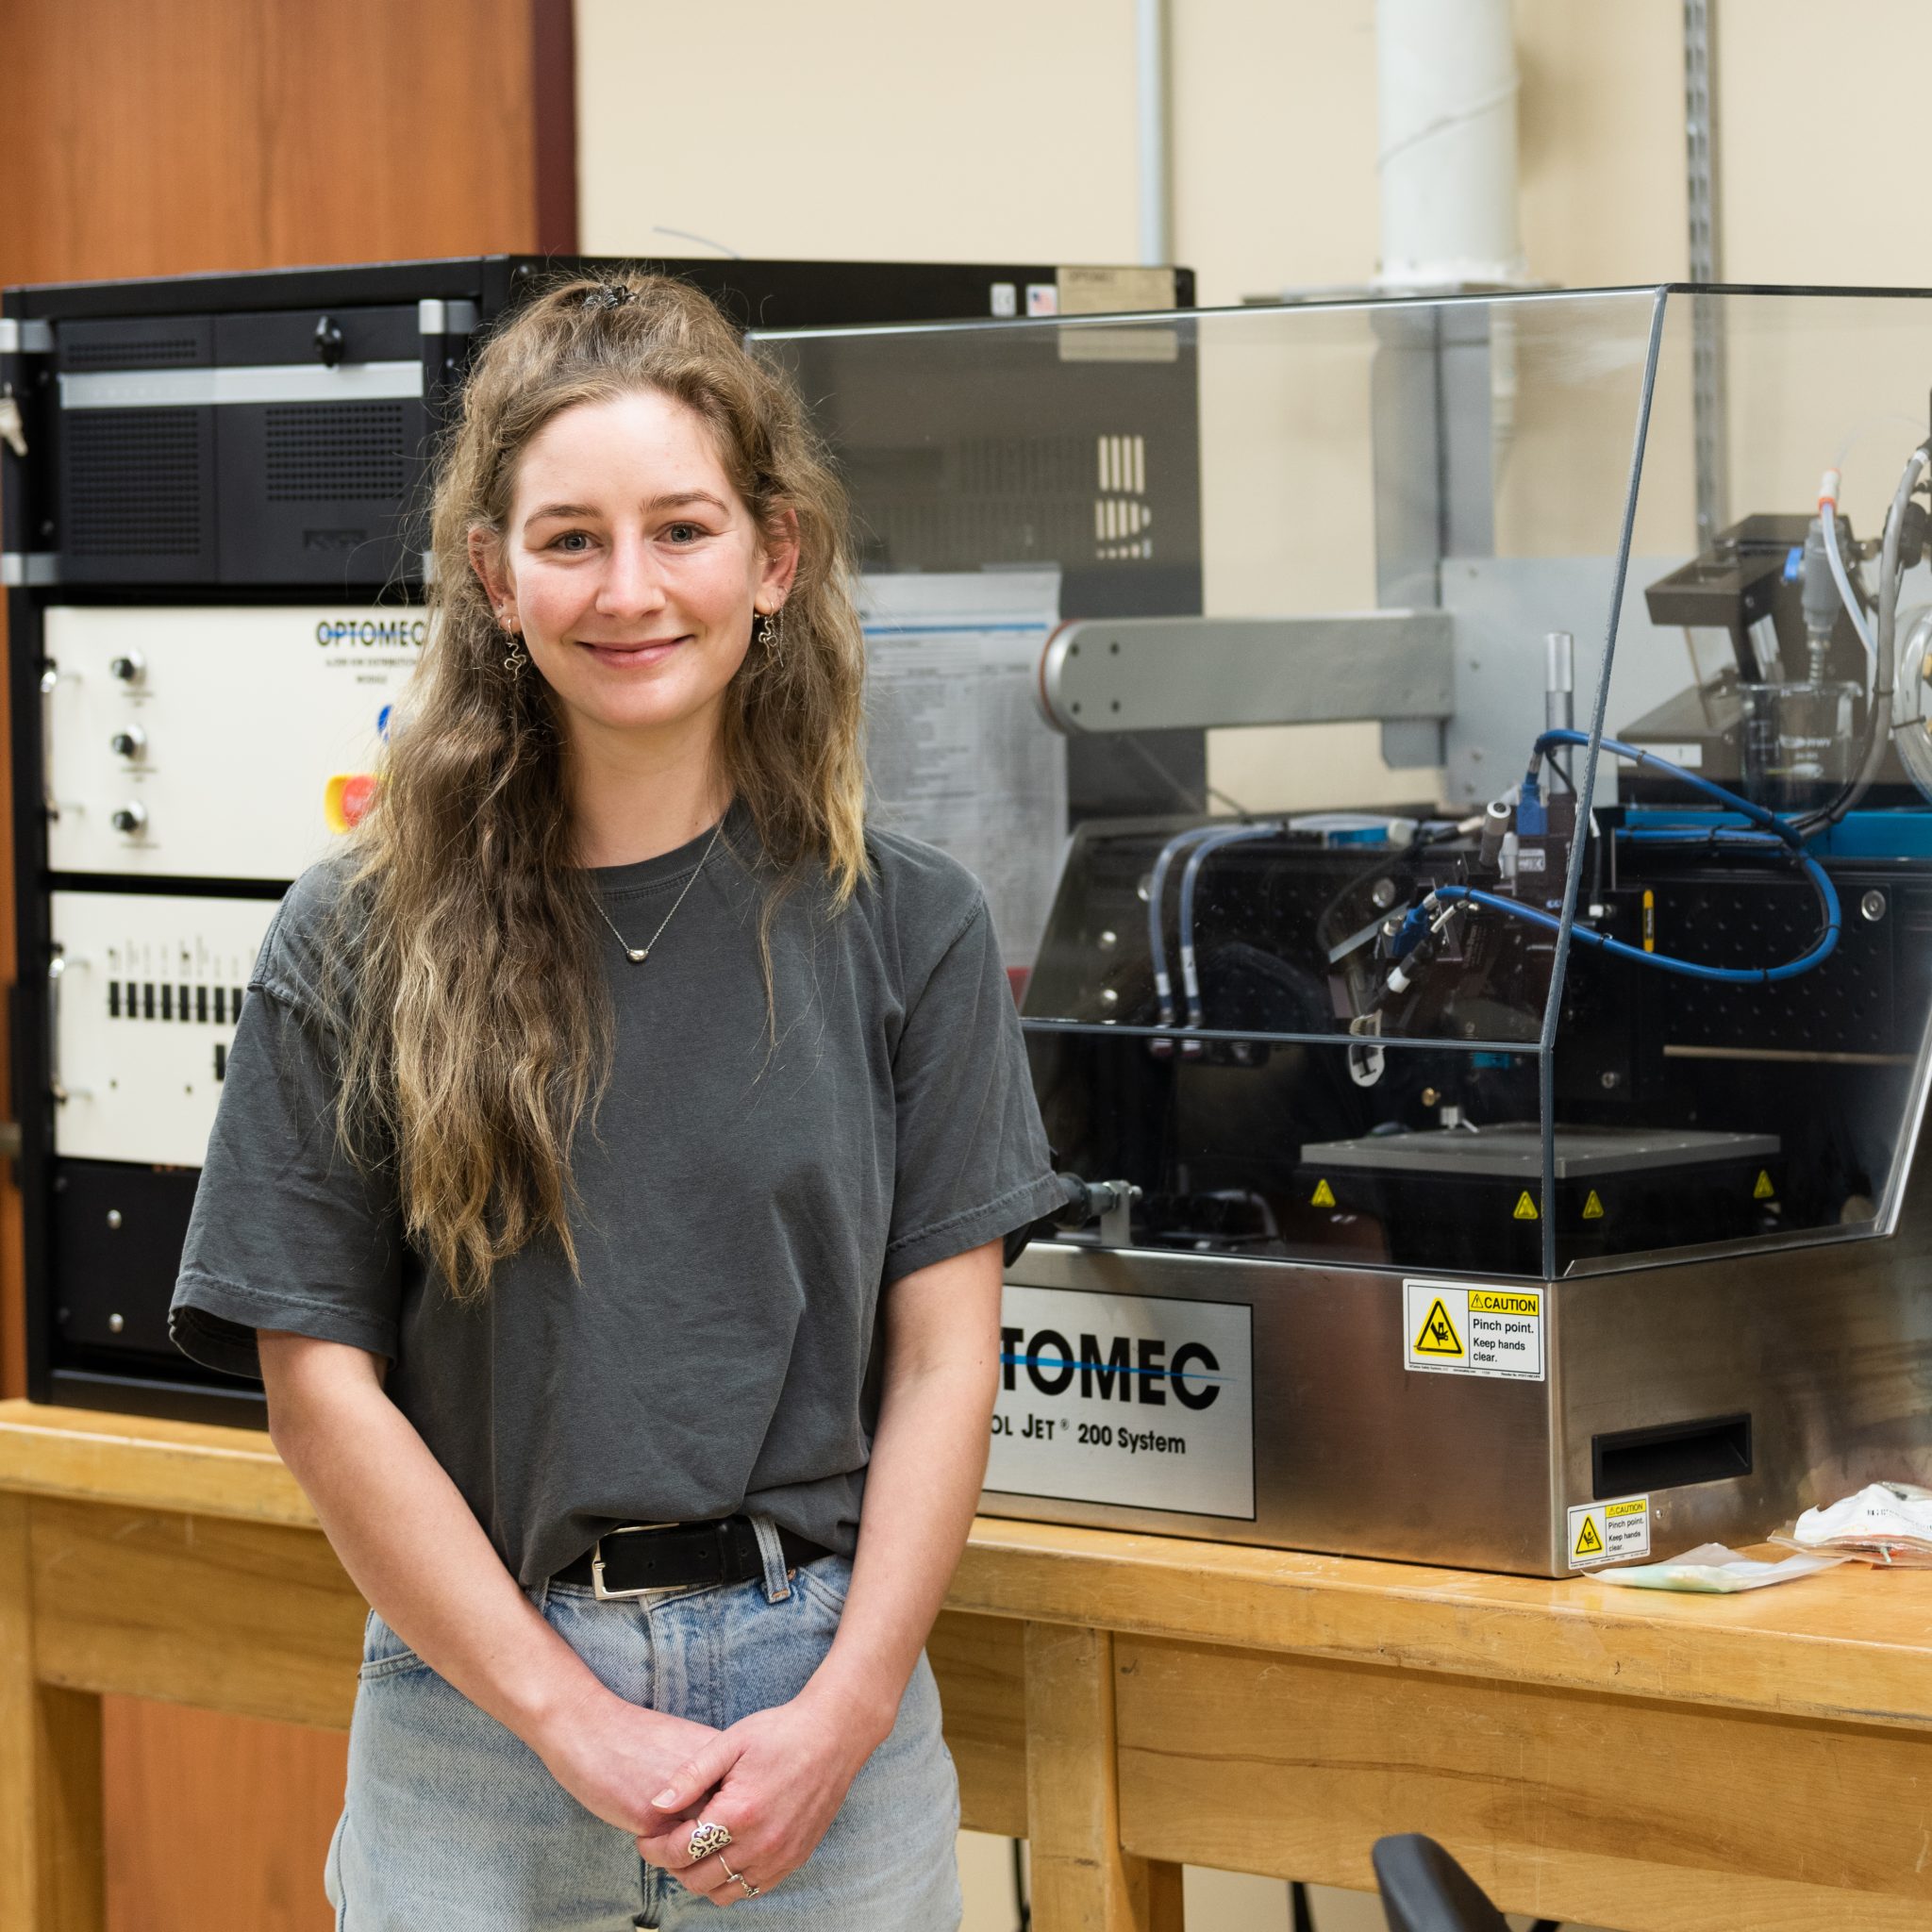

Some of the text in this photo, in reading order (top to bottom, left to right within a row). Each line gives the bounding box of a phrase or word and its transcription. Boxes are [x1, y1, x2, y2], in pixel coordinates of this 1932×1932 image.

[317, 621, 424, 646] OPTOMEC
[1484, 1297, 1536, 1312] CAUTION
[1473, 1318, 1534, 1334] Pinch point.
[1473, 1338, 1525, 1351] Keep hands
[1473, 1352, 1498, 1362] clear.
[1000, 1326, 1221, 1410] TOMEC
[1078, 1423, 1112, 1446] 200
[1118, 1426, 1186, 1454] System
[1615, 1502, 1643, 1514] CAUTION
[1607, 1518, 1644, 1529] Pinch point.
[1608, 1531, 1641, 1541] Keep hands
